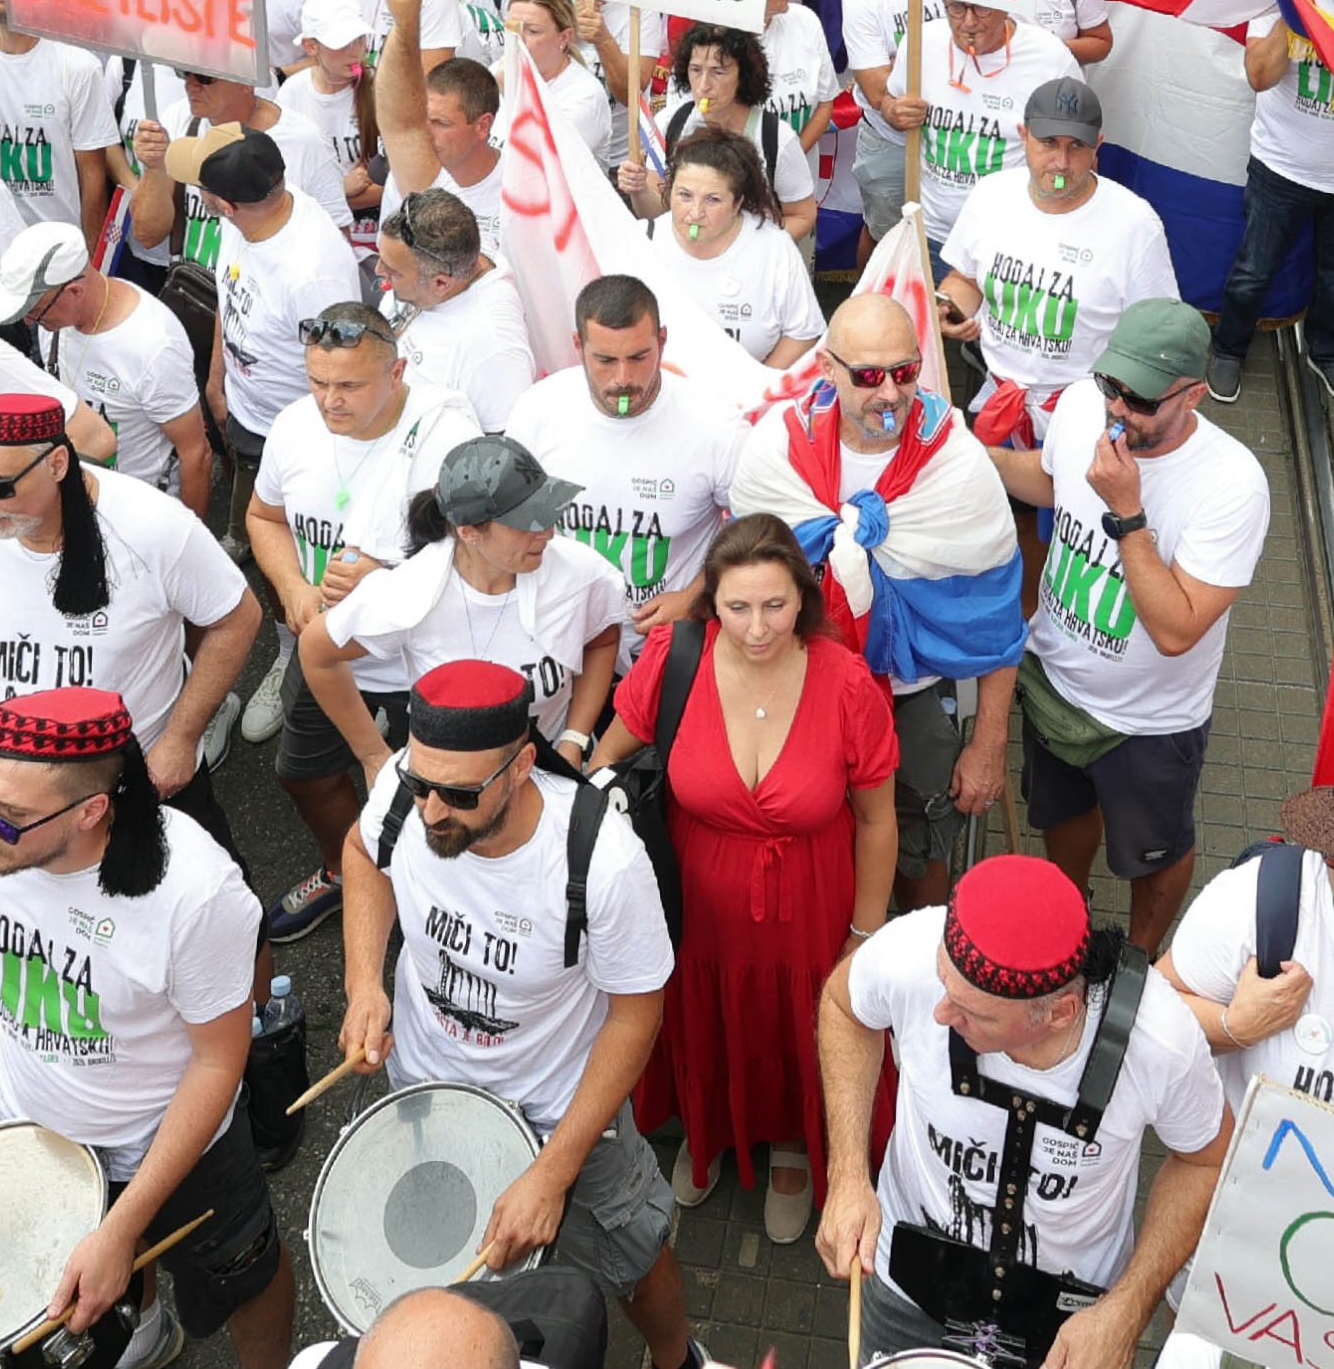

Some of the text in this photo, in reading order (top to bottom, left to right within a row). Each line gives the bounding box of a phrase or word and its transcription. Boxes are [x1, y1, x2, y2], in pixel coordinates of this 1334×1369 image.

[25, 127, 47, 148] ZA
[925, 105, 1001, 142] HODAJ ZA
[920, 124, 1007, 176] LIKU
[989, 251, 1075, 303] HODAJ ZA
[983, 271, 1080, 342] LIKU
[1016, 328, 1073, 354] HRVATSKU!
[631, 510, 665, 541] ZA
[1064, 611, 1130, 655] HRVATSKU!
[53, 644, 94, 688] TO!
[424, 904, 518, 976] MIČI TO!
[61, 946, 94, 998] ZA
[34, 1026, 114, 1057] HRVATSKU!
[927, 1122, 998, 1184] MIČI
[1041, 1135, 1080, 1149] GOSPIĆ
[1043, 1146, 1055, 1156] JE
[1051, 1156, 1077, 1167] DOM
